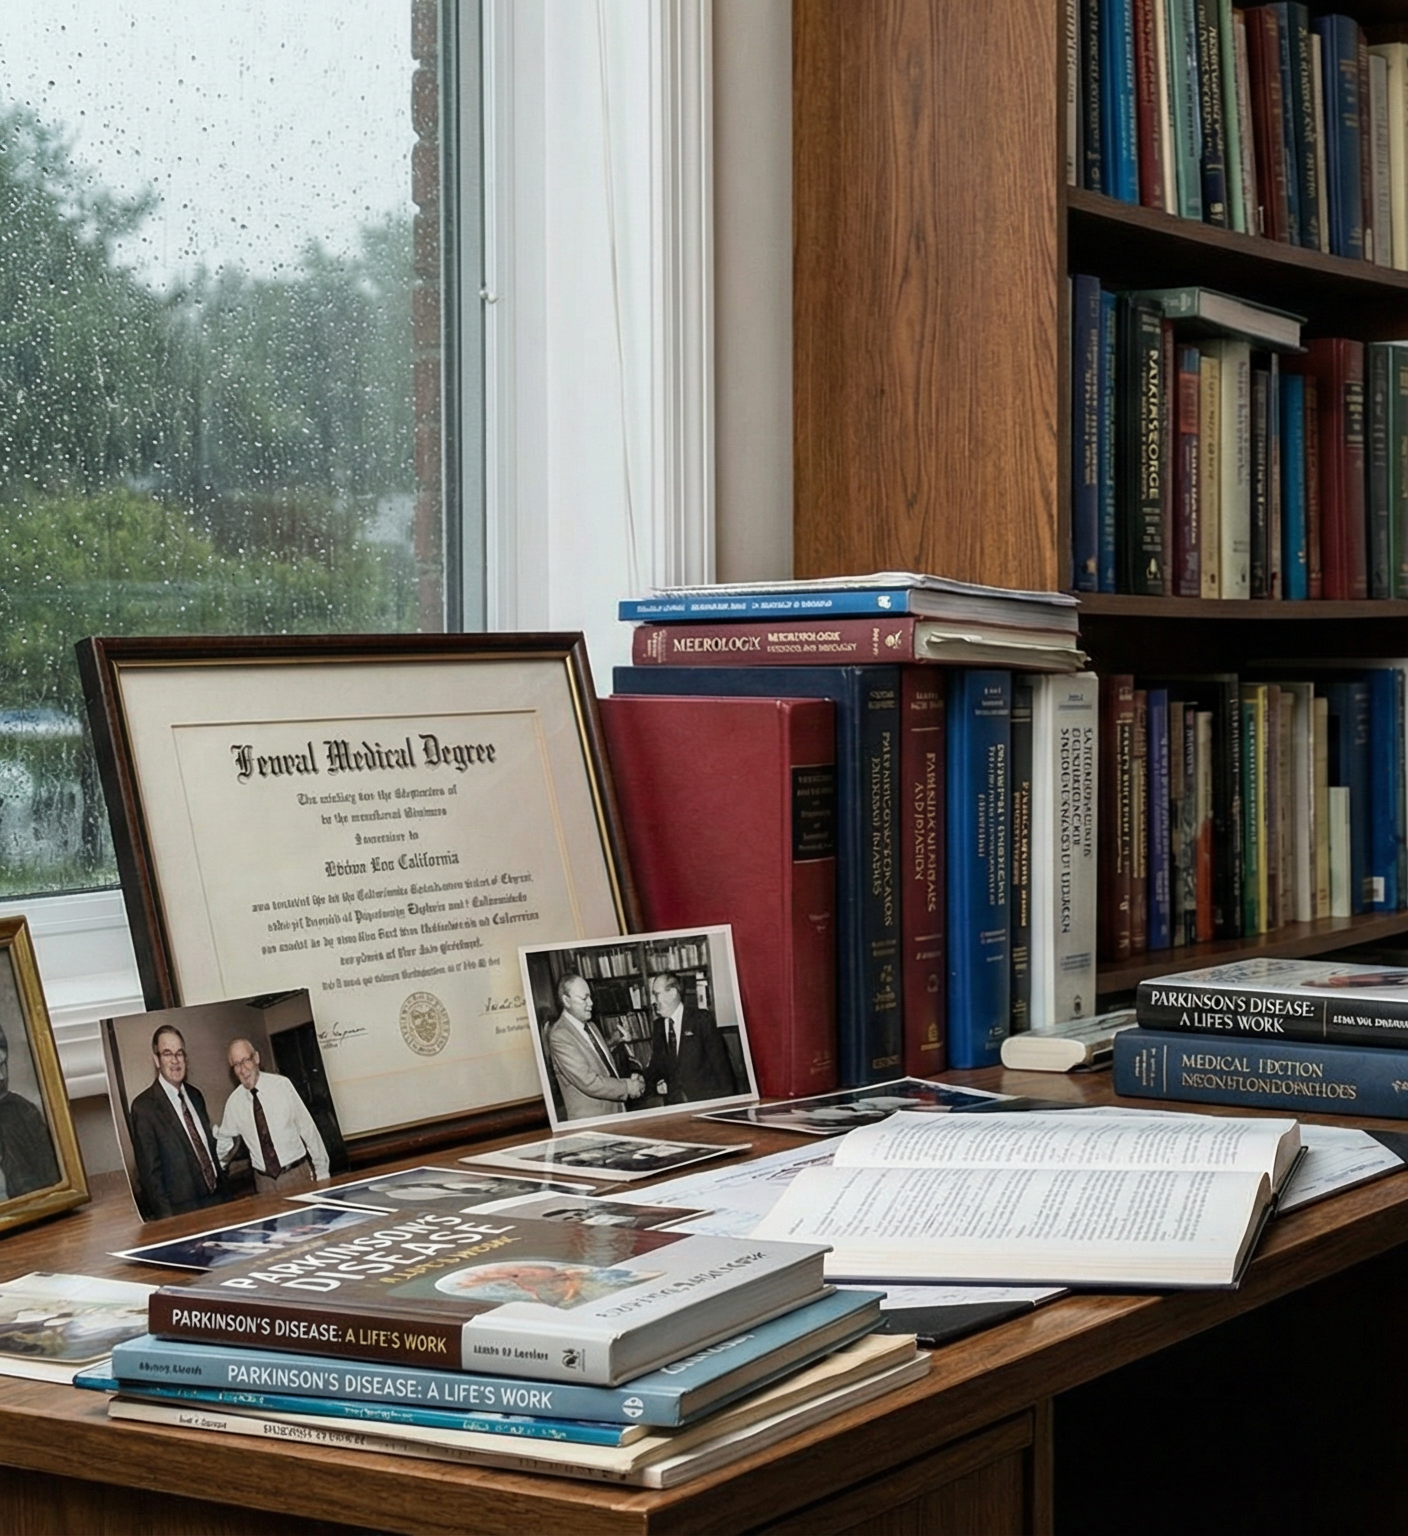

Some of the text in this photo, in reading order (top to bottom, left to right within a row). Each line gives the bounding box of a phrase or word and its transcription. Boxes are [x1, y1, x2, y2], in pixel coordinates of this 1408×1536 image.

[323, 736, 416, 776] Medical
[418, 733, 497, 773] Degree
[398, 850, 460, 870] California
[1150, 990, 1247, 1012] PARKINSON'S
[1179, 1012, 1191, 1026] A
[1237, 1015, 1285, 1033] WORK
[1181, 1054, 1251, 1073] MEDICAL
[219, 1214, 463, 1290] PARKINSON'S
[279, 1221, 516, 1293] DISEASE
[171, 1308, 271, 1336] PARKINSON'S
[274, 1318, 343, 1343] DISEASE:
[345, 1327, 356, 1344] A
[404, 1333, 447, 1354] WORK
[227, 1364, 340, 1391] PARKINSON'S
[344, 1374, 423, 1400] DISEASE:
[426, 1382, 440, 1400] A
[443, 1382, 496, 1405] LIFE'S
[499, 1387, 553, 1410] WORK
